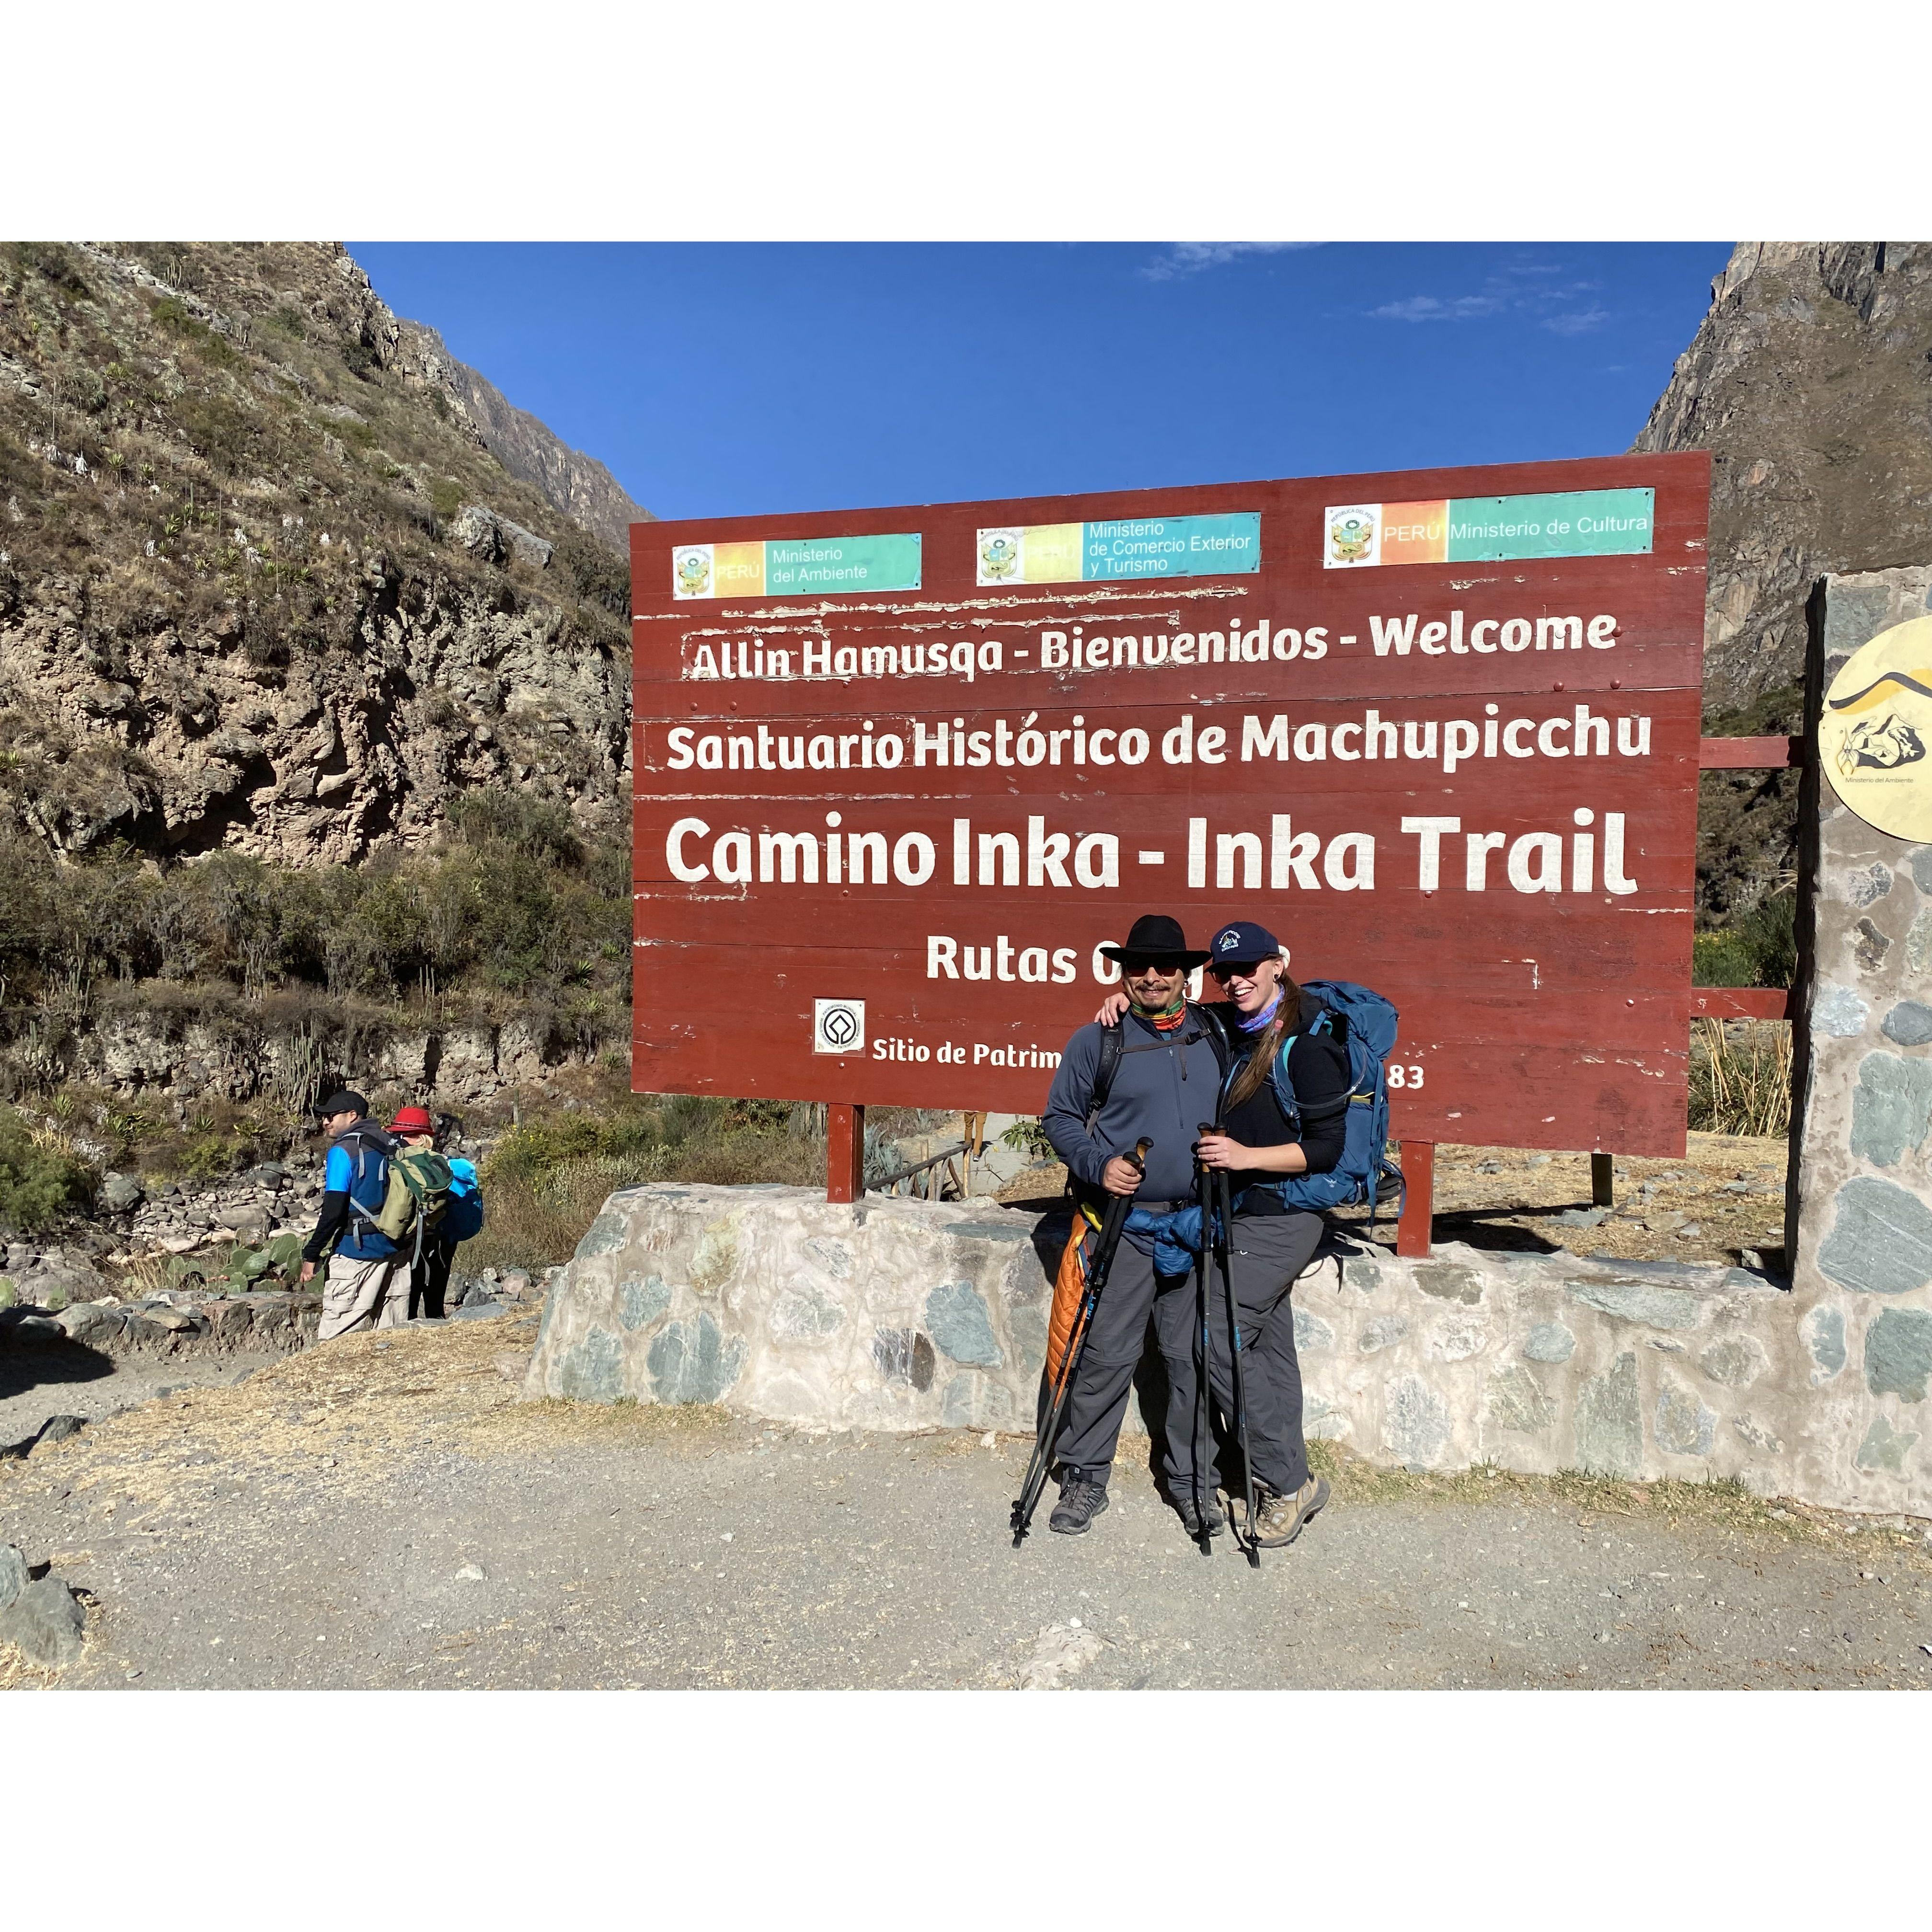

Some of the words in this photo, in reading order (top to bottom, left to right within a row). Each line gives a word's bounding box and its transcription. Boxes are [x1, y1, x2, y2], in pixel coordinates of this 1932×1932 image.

[1089, 520, 1164, 539] Ministerio
[1384, 521, 1440, 542] PERÚ
[1450, 520, 1541, 540] Ministerio
[1546, 519, 1570, 535] de
[1577, 516, 1648, 534] Cultura
[773, 546, 842, 564] Ministerio
[1089, 544, 1107, 557] de
[1113, 537, 1185, 556] Comercio
[1191, 534, 1252, 552] Exterior
[716, 561, 759, 580] PERÚ
[773, 569, 794, 583] del
[798, 565, 867, 582] Ambiente
[1090, 562, 1099, 578] y
[1104, 557, 1168, 574] Turismo
[690, 638, 790, 679] Allin
[803, 639, 1002, 683] Hamusqa
[1041, 618, 1328, 668] Bienvenidos
[1340, 635, 1357, 644] -
[1368, 610, 1617, 656] Welcome
[667, 720, 904, 770] Santuario
[914, 711, 1150, 767] Histórico
[1162, 714, 1227, 765] de
[1241, 702, 1652, 774] Machupicchu
[666, 811, 936, 886] Camino
[954, 815, 1120, 888] Inka
[1138, 851, 1164, 864] -
[1188, 814, 1375, 892] Inka
[1401, 807, 1638, 895] Trail
[927, 935, 1077, 984] Rutas
[822, 1004, 843, 1016] PATRIMONIO
[872, 1038, 930, 1062] Sitio
[937, 1041, 966, 1064] de
[974, 1043, 1062, 1069] Patrim
[1387, 1065, 1424, 1089] 83
